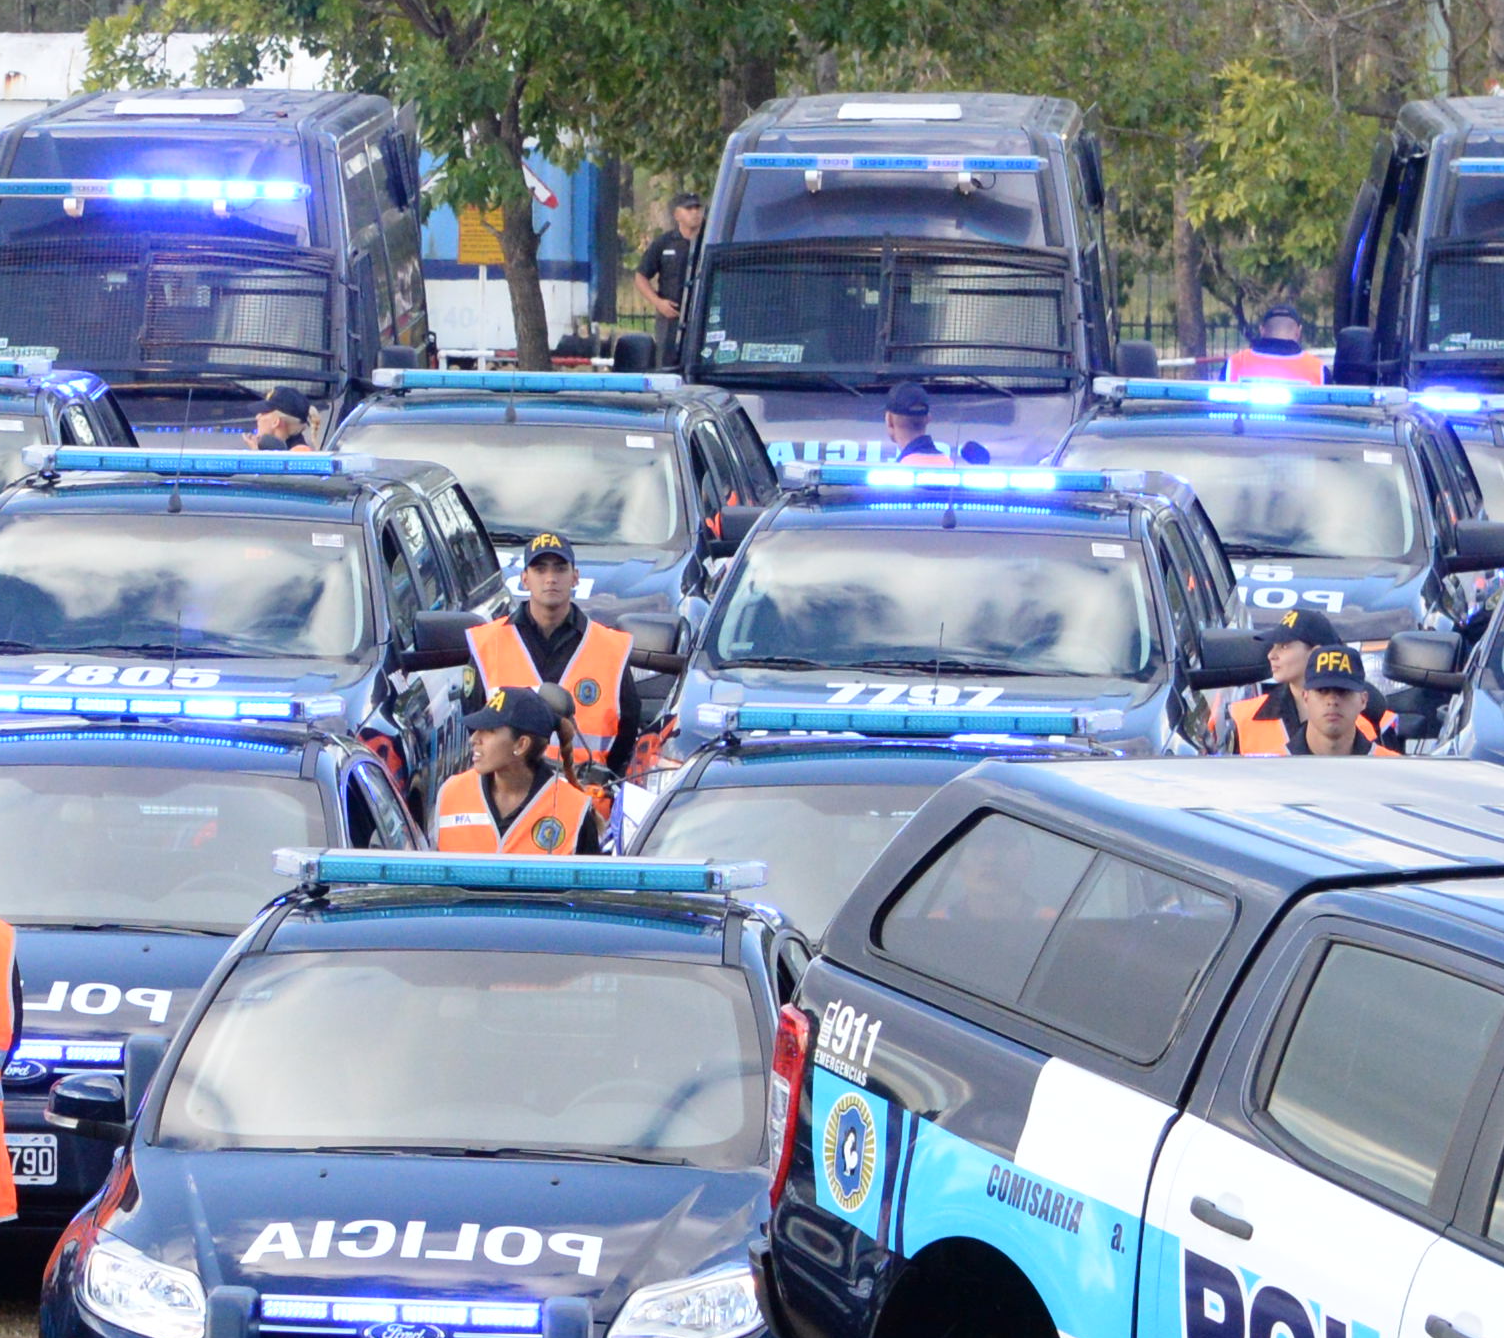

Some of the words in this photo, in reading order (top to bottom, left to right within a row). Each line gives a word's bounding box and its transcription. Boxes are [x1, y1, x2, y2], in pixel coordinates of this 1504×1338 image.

[531, 533, 562, 552] PFA
[1316, 652, 1352, 674] PFA
[33, 666, 221, 689] 7805
[826, 683, 1005, 706] 7797
[832, 1004, 883, 1068] 911
[4, 1063, 30, 1076] ord
[814, 1050, 868, 1088] EMERGENCIAS
[8, 1147, 53, 1175] 790
[985, 1163, 1085, 1236] COMISARIA
[1110, 1222, 1126, 1254] a.
